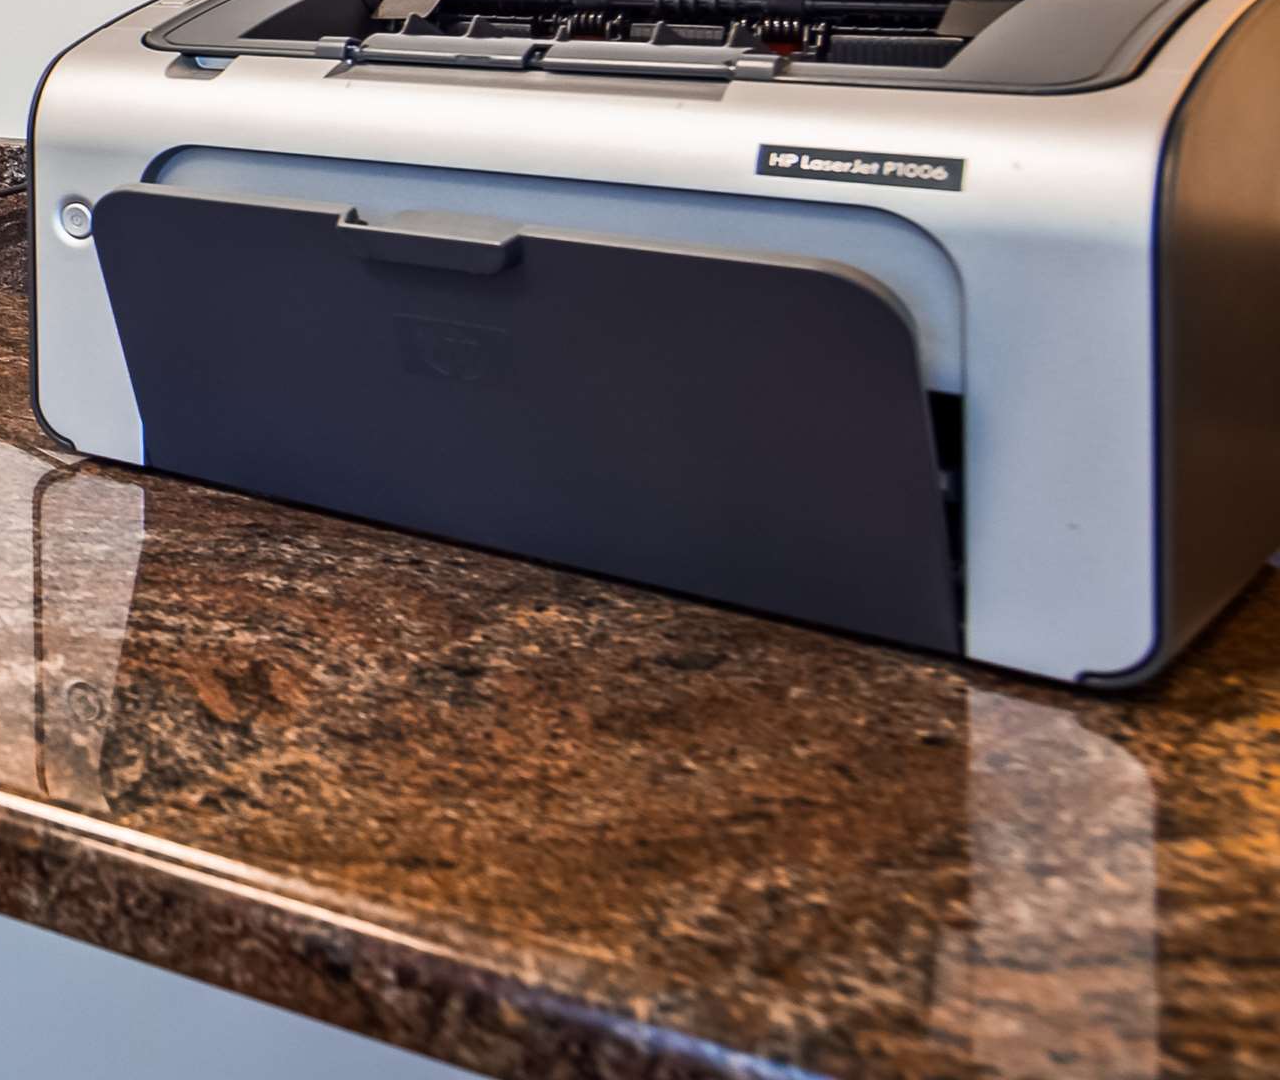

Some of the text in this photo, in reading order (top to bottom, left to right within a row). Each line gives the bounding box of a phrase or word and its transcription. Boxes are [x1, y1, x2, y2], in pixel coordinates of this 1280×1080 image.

[768, 152, 949, 180] HP LaserJet P1006
